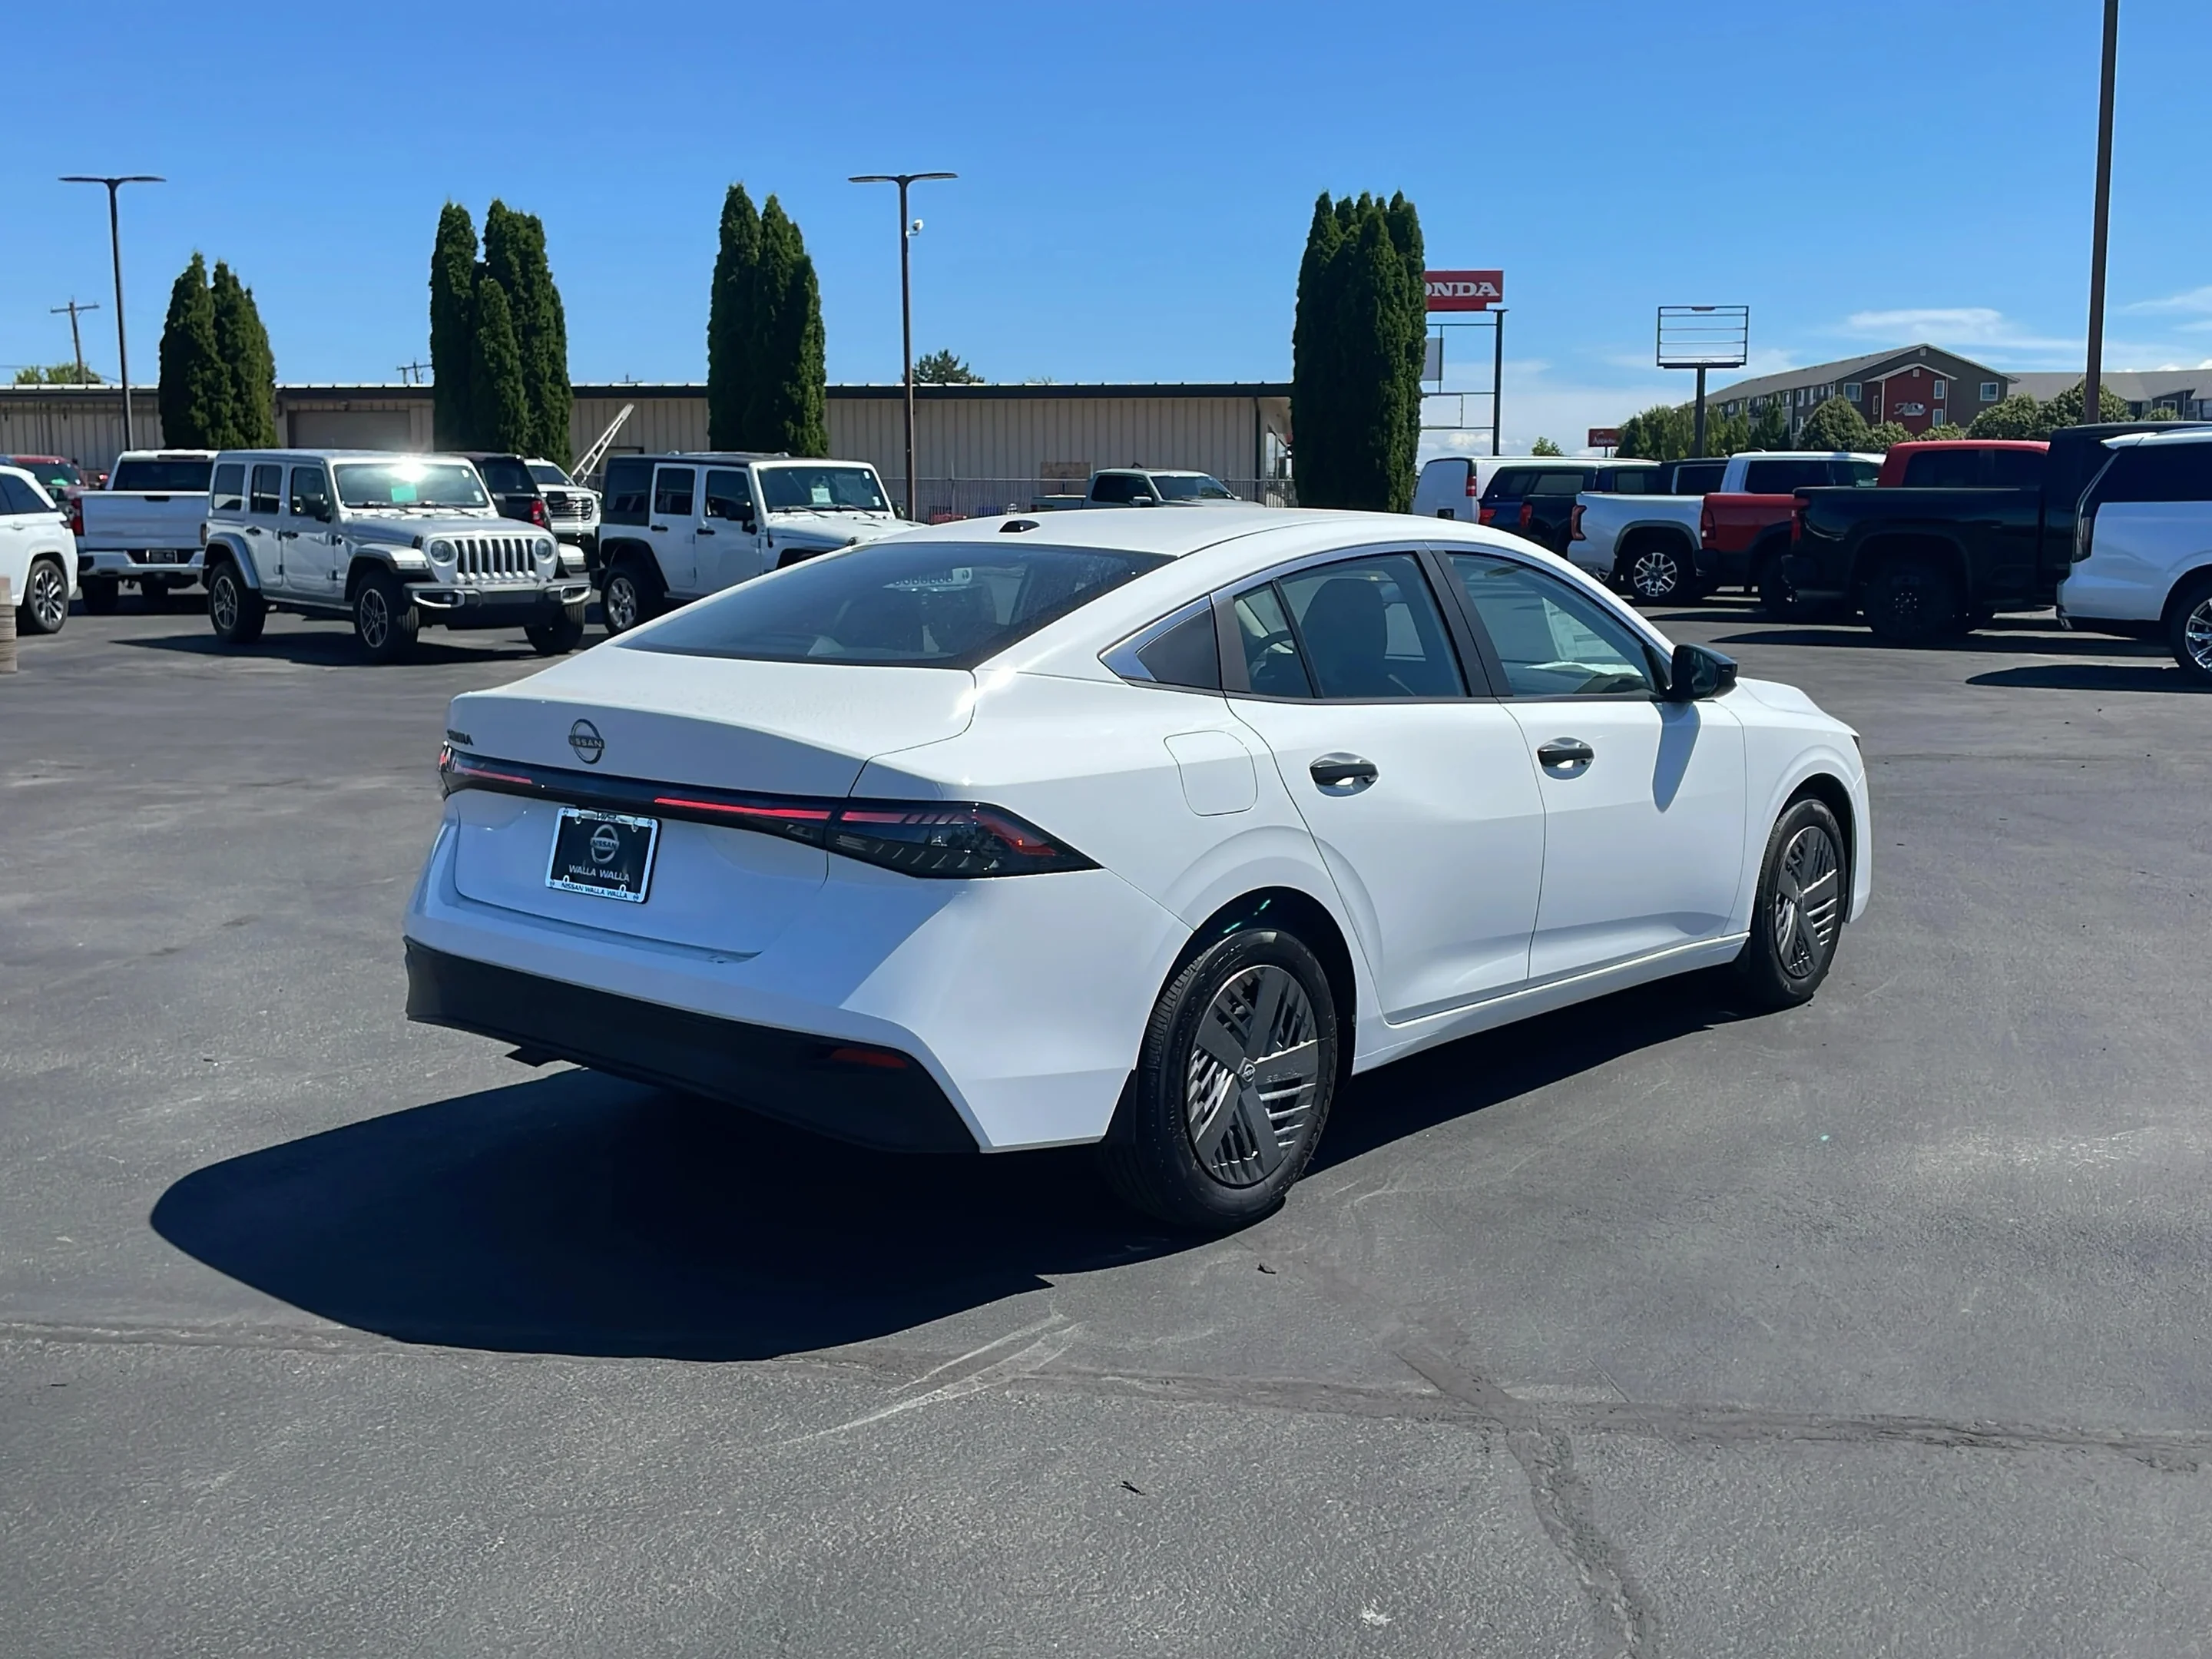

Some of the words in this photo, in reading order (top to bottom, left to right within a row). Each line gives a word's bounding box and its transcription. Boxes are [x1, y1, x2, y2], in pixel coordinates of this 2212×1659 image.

[1426, 282, 1500, 296] NDA
[592, 839, 617, 849] NISSAN
[568, 864, 596, 876] WALLA
[600, 869, 630, 882] WALLA
[561, 883, 583, 892] NISSAN
[585, 886, 605, 896] WALLA
[607, 891, 628, 899] WALLA
